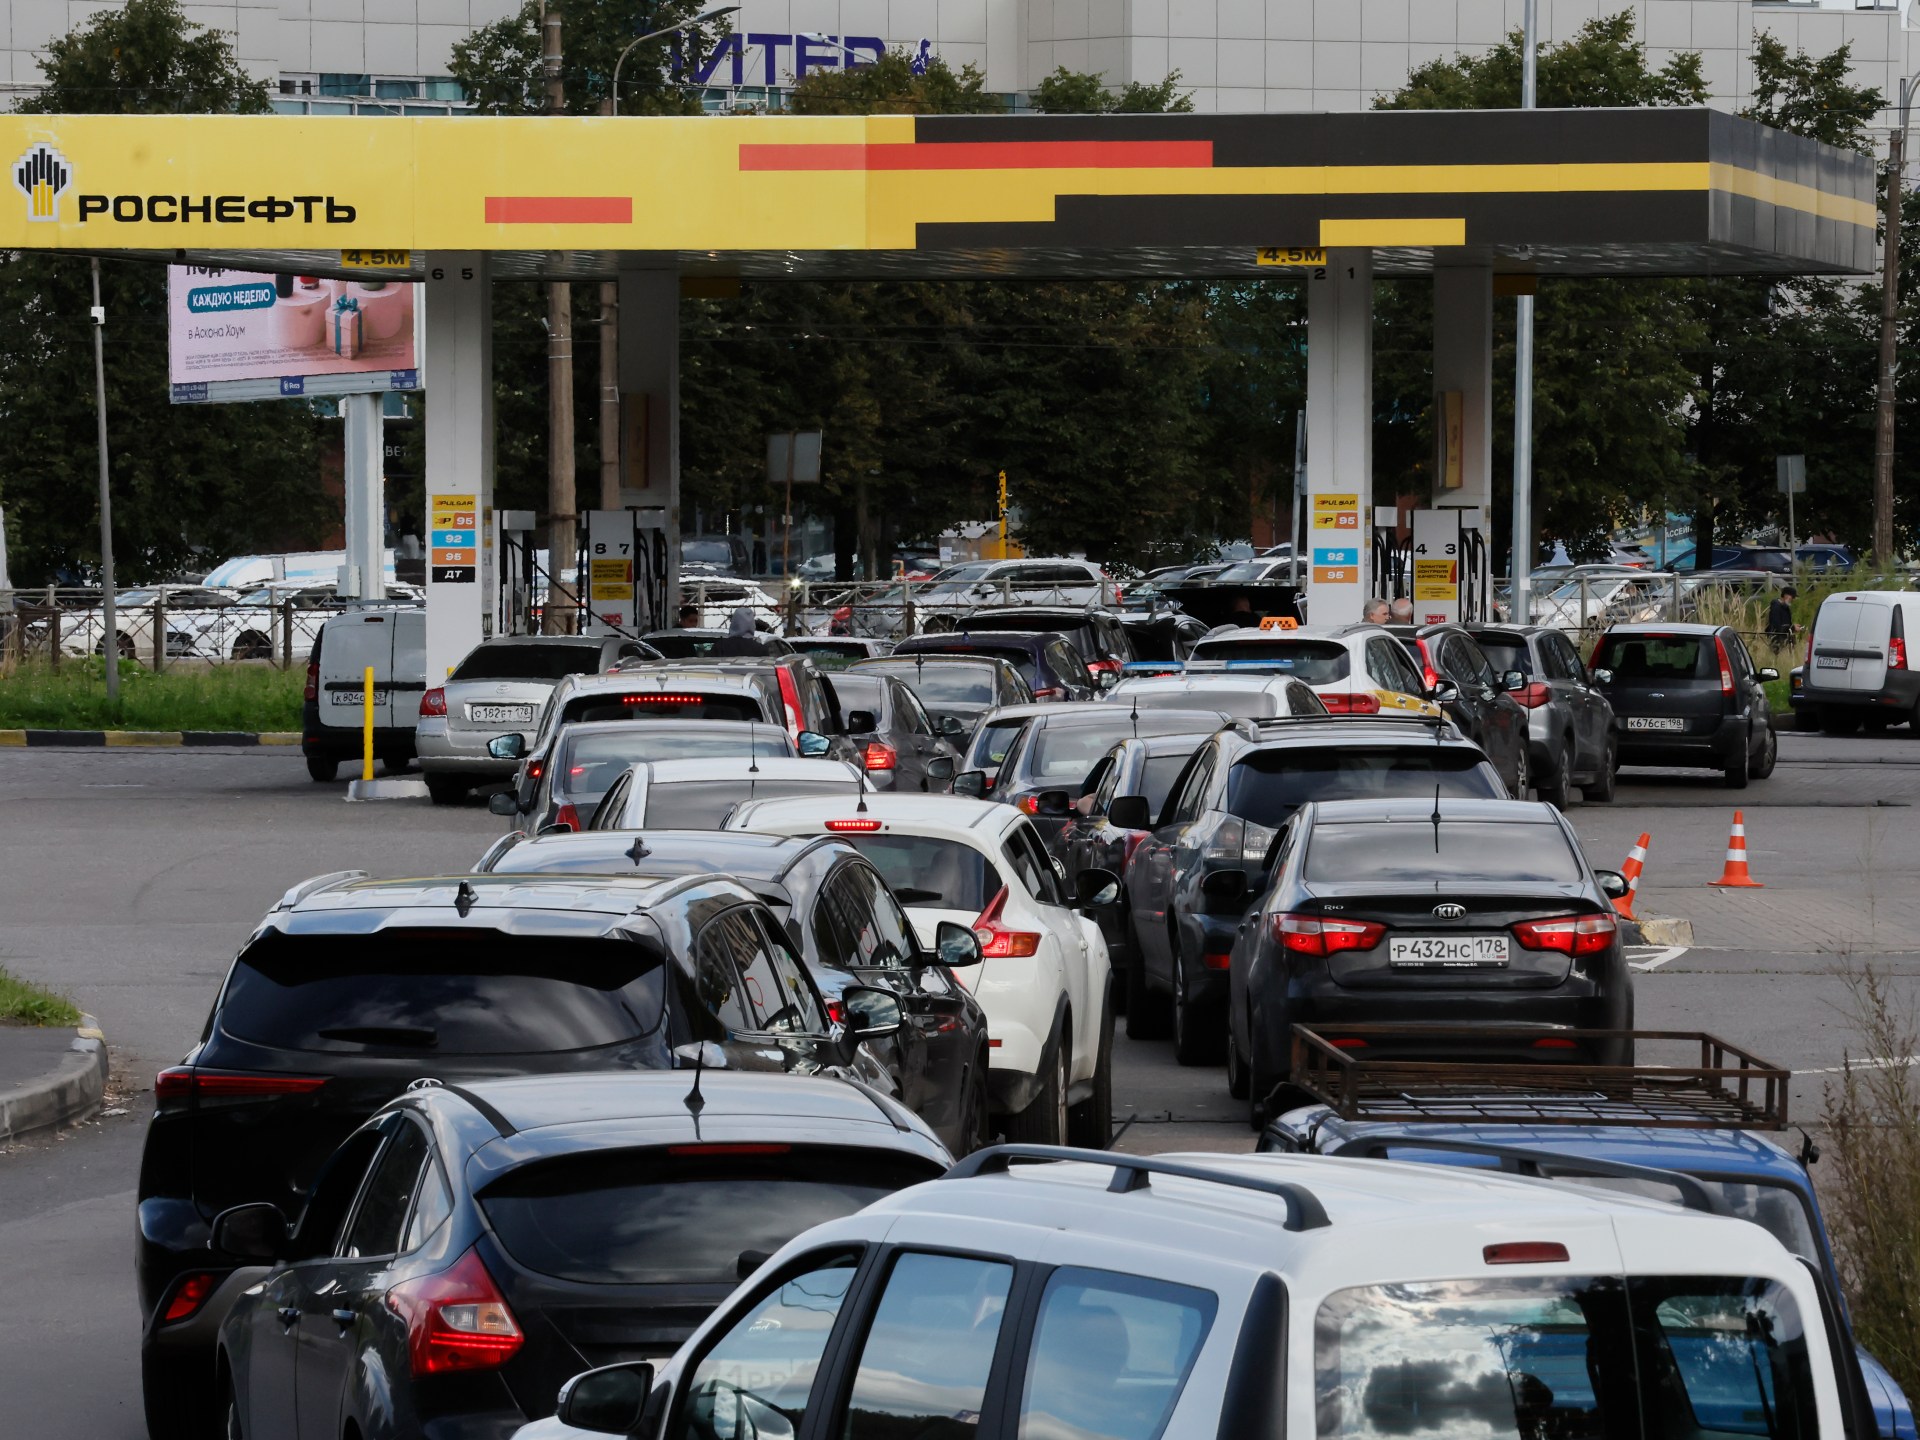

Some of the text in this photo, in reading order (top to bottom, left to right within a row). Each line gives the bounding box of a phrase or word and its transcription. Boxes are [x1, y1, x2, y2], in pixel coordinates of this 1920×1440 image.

[78, 194, 357, 224] РОСНЕФТЬ
[431, 268, 474, 280] 6 5
[1313, 267, 1355, 280] 2 1
[192, 288, 271, 308] КАЖДУЮ НЕДЕЛЮ
[188, 329, 194, 339] в
[225, 324, 246, 339] Хоум
[456, 516, 473, 525] 95
[1338, 516, 1356, 525] 95
[445, 534, 463, 543] 92
[594, 542, 630, 555] 8 7
[1415, 543, 1457, 555] 4 3
[445, 552, 462, 561] 95
[1327, 552, 1345, 561] 92
[444, 570, 463, 580] ДТ
[1327, 571, 1345, 579] 95
[1629, 718, 1681, 728] К676СЕ 198
[1437, 906, 1462, 918] KIA
[1396, 939, 1503, 960] Р432НС 178
